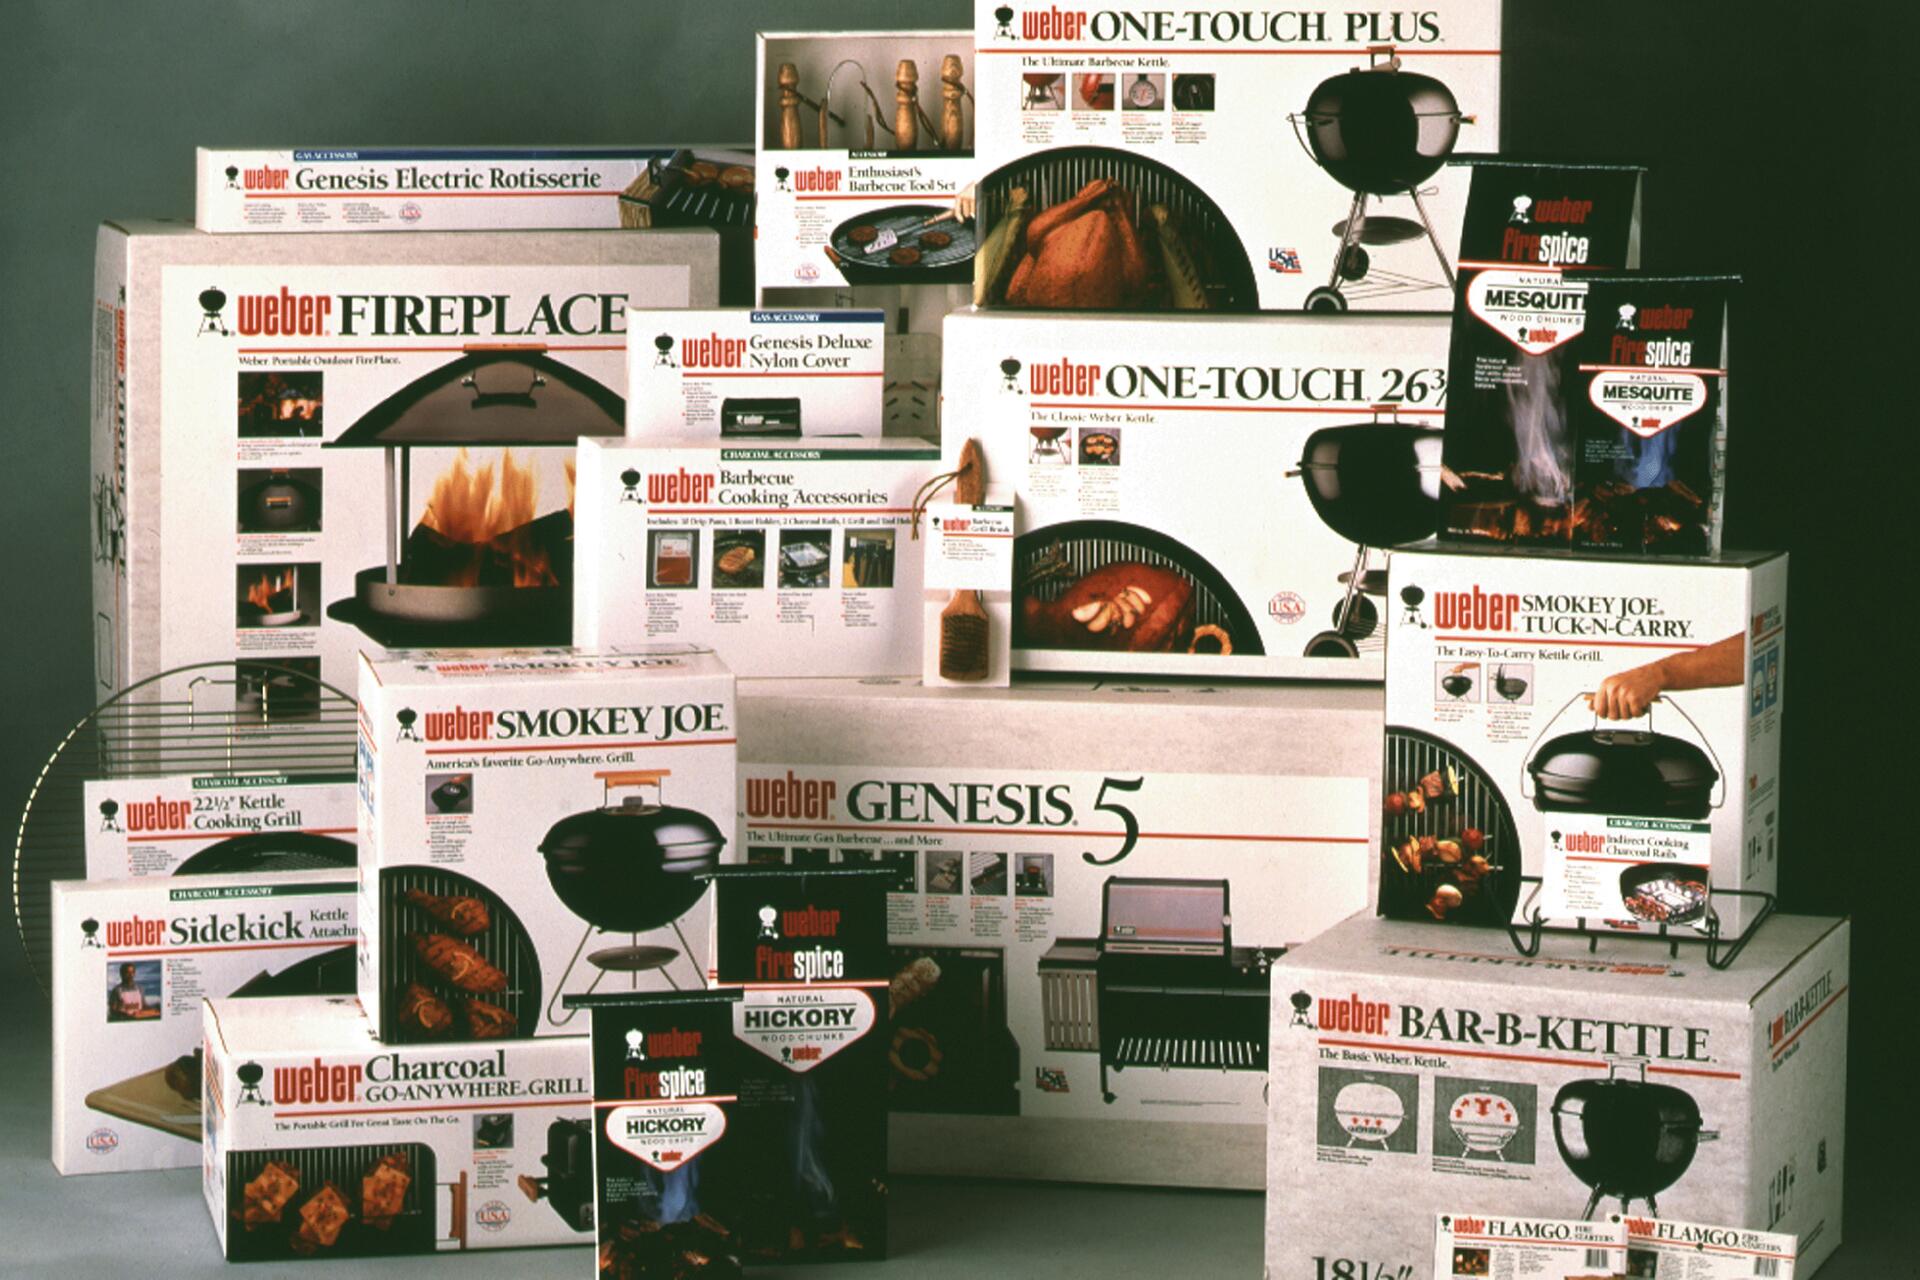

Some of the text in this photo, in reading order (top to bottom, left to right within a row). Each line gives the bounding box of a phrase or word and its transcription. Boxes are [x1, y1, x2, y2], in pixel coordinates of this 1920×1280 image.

[1021, 4, 1441, 43] weber ONE-TOUCH PLUS
[1021, 57, 1040, 67] The
[1042, 57, 1086, 67] Ultimate
[1088, 57, 1136, 67] Barbecue
[244, 164, 602, 190] weber Genesis Electric Rotisserie
[795, 166, 922, 192] weber Enthusiast's
[849, 180, 957, 192] Barbecue Tool Set
[1534, 196, 1592, 224] weber
[1484, 289, 1585, 310] MESQUIT
[237, 286, 630, 338] weber FIREPLACE
[1640, 304, 1693, 330] weber
[272, 356, 311, 366] Portable
[313, 355, 354, 366] Outdoor
[682, 332, 872, 369] weber Genesis Deluxe
[749, 353, 851, 373] Nylon Cover
[1030, 357, 1363, 402] weber ONE-TOUCH
[1603, 386, 1694, 401] MESQUITE
[1030, 411, 1048, 422] The
[1050, 412, 1087, 422] Classic
[1090, 412, 1122, 423] Weber
[648, 466, 794, 505] weber Barbecue
[718, 489, 888, 509] Cooking Accessories
[1434, 584, 1661, 631] weber SMOKEY JOE
[1522, 616, 1691, 638] TUCK-N-CARRY
[1436, 645, 1603, 662] The Easy-To-Carry Kettle Grill.
[425, 703, 726, 742] weber SMOKEY JOE
[426, 757, 480, 770] America's
[482, 755, 524, 768] favorite
[606, 752, 635, 764] Grill.
[127, 795, 191, 832] weber
[239, 793, 285, 810] Kettle
[194, 812, 302, 832] Cooking Grill
[746, 770, 1145, 866] weber GENESIS 5
[746, 831, 943, 846] The Ultimate Gas More
[1565, 832, 1689, 853] weber Indirect Cooking
[1606, 845, 1677, 859] Charcoal Rails
[106, 909, 349, 947] weber Sidekick Kettle
[782, 905, 840, 938] weber
[777, 995, 824, 1003] NATURAL
[744, 1008, 856, 1027] HICKORY
[1317, 992, 1710, 1062] weber BAR-B-KETTLE
[648, 1028, 702, 1058] weber
[761, 1032, 844, 1042] WOOD CHUNKS
[792, 1044, 822, 1060] weber
[1318, 1048, 1340, 1060] The
[1342, 1050, 1369, 1062] Basic
[1415, 1056, 1450, 1069] Kettle.
[274, 1050, 506, 1104] weber Charcoal
[365, 1078, 589, 1103] GO-ANYWHERE GRILL
[275, 1122, 291, 1131] The
[293, 1121, 327, 1130] Portable
[329, 1119, 349, 1129] Grill
[351, 1119, 365, 1128] For
[366, 1118, 389, 1127] Great
[414, 1116, 428, 1124] On
[429, 1115, 445, 1124] The
[626, 1117, 706, 1134] HICKORY
[1489, 1221, 1569, 1240] FLAMGO
[1575, 1233, 1615, 1242] STARTERS
[1658, 1223, 1739, 1247] FLAMGO
[1741, 1241, 1781, 1253] STARTERS
